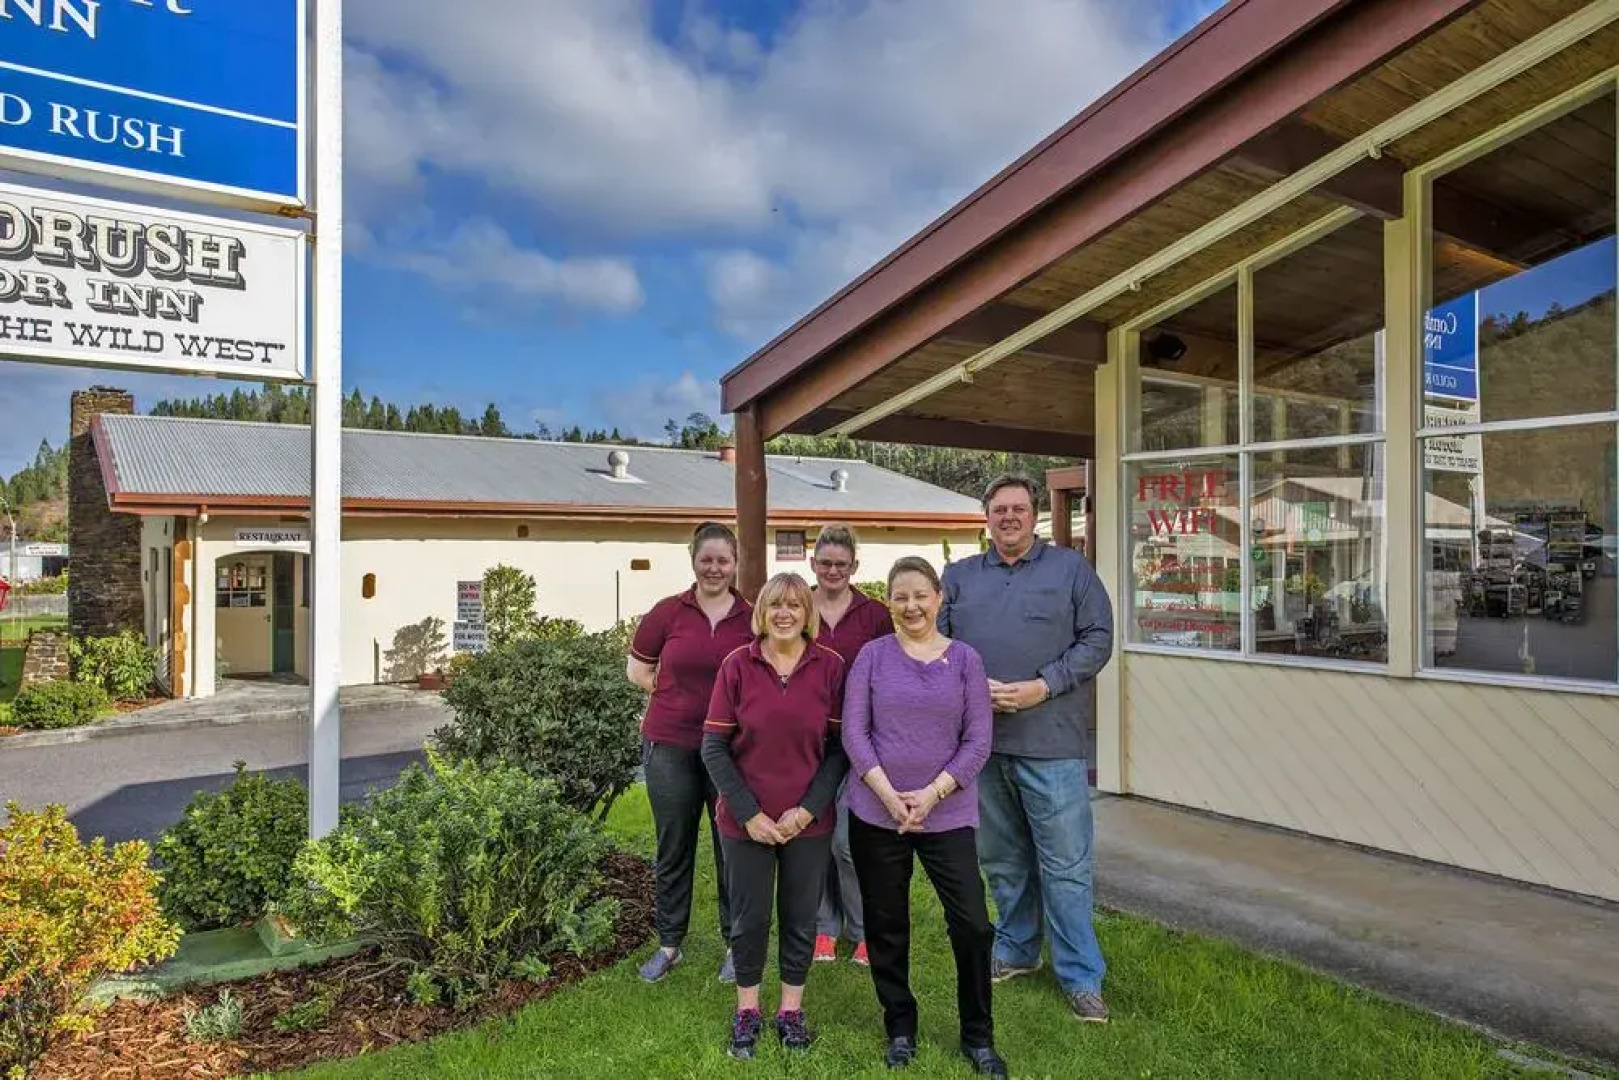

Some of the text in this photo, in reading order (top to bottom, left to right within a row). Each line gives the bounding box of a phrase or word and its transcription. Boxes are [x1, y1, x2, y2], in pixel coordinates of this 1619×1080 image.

[48, 101, 186, 158] RUSH
[86, 278, 204, 323] INN
[64, 321, 165, 353] WILD
[1137, 468, 1229, 503] FREE
[239, 532, 301, 542] RESTAURANT
